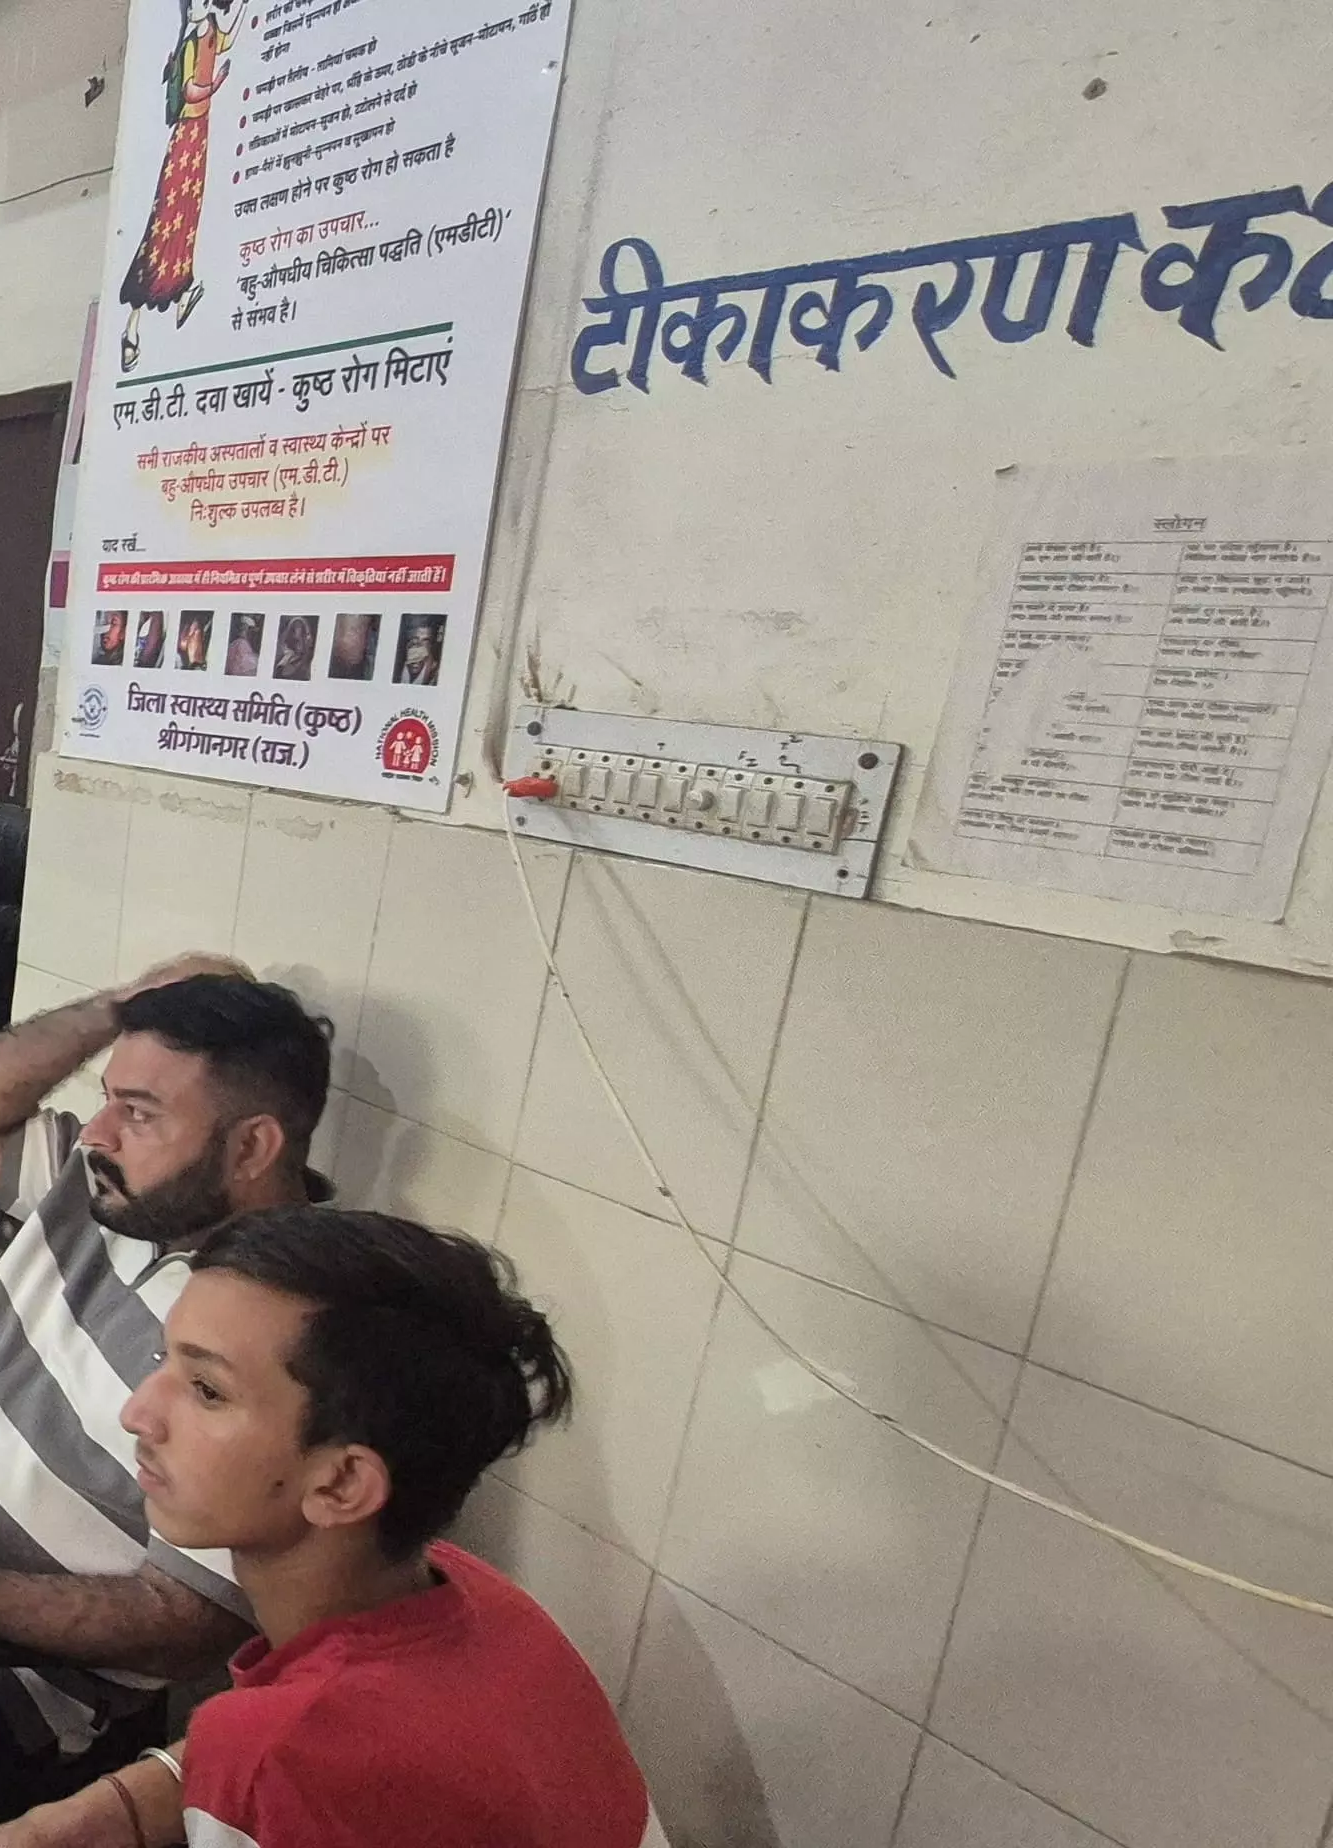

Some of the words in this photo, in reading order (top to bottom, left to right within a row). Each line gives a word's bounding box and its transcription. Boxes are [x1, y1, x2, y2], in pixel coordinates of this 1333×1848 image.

[385, 116, 397, 136] हो
[234, 197, 258, 218] उक्त
[260, 188, 288, 211] लक्षण
[291, 176, 313, 203] होने
[315, 175, 331, 195] पर
[333, 167, 359, 195] कुष्ठ
[361, 156, 383, 181] रोग
[385, 149, 400, 175] हो
[402, 139, 444, 168] सकता
[444, 132, 456, 158] है
[239, 236, 268, 267] कुष्ठ
[270, 226, 294, 253] रोग
[296, 222, 315, 245] का
[315, 245, 375, 279] चिकित्सा
[379, 228, 424, 263] पद्धति
[231, 306, 243, 331] से
[246, 300, 277, 328] संभव
[570, 212, 1149, 396] टीकाकरण
[113, 387, 188, 430] एम.डी.टी.
[195, 385, 229, 414] दवा
[231, 368, 275, 410] खायें
[292, 367, 335, 412] कुष्ठ
[341, 354, 379, 393] रोग
[383, 336, 454, 388] मिटाएं
[136, 446, 159, 471] सभी
[160, 441, 208, 467] राजकीय
[210, 432, 266, 463] अस्पतालों
[268, 440, 279, 457] व
[281, 433, 328, 461] स्वास्थ्य
[331, 422, 369, 450] केन्द्रों
[371, 424, 392, 446] पर
[229, 468, 270, 491] उपचार
[273, 458, 350, 493] (एम.डी.टी.)
[241, 498, 287, 520] उपलब्ध
[101, 538, 119, 552] याद
[387, 567, 406, 583] नहीं
[127, 682, 167, 714] जिला
[170, 695, 230, 720] स्वास्थ्य
[232, 691, 293, 727] समिति
[294, 701, 362, 737] (कुष्ठ)
[157, 721, 249, 759] श्रीगंगानगर
[252, 735, 310, 770] (राज.)
